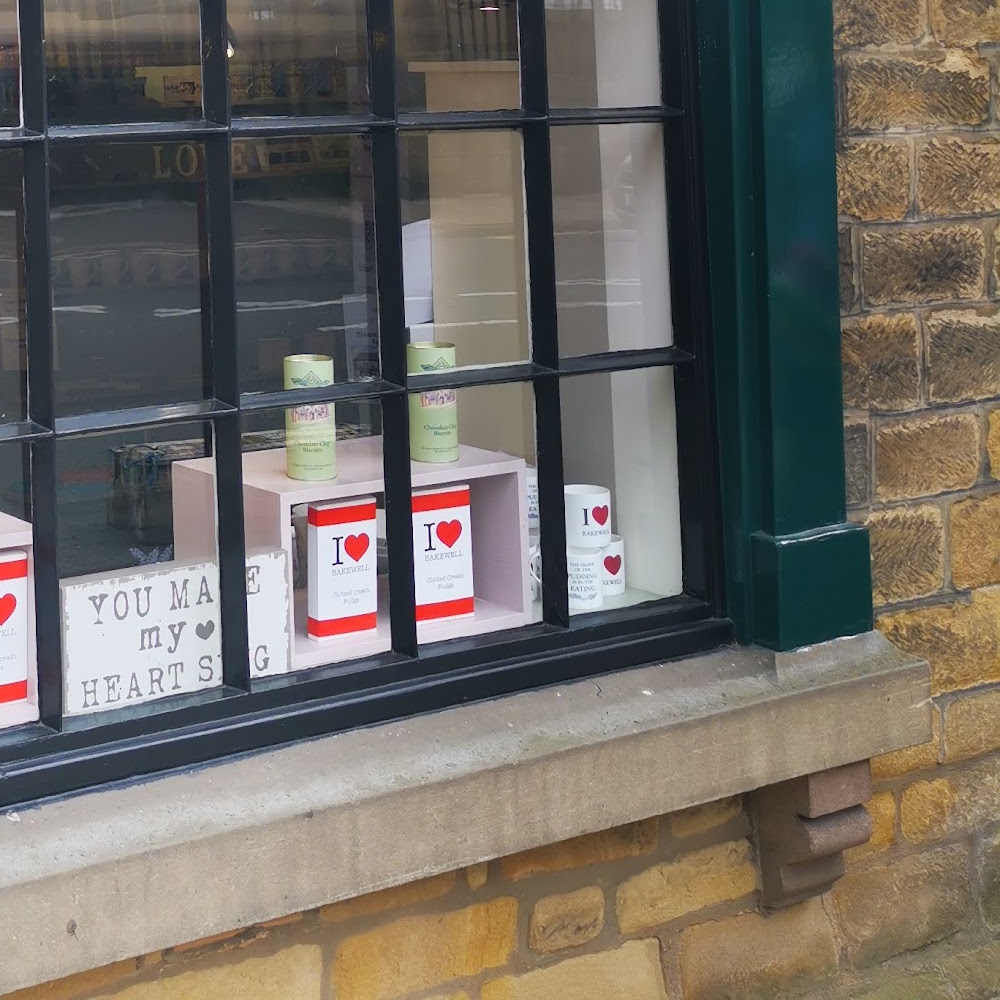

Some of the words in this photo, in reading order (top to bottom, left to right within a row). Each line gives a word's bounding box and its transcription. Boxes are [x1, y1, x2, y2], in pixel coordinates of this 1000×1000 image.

[152, 143, 248, 179] LOE
[582, 507, 590, 526] I
[332, 536, 344, 566] I
[423, 522, 437, 552] I
[331, 564, 370, 576] BAKEWELL
[424, 550, 464, 562] BAKEWELL
[88, 586, 152, 625] YOU
[169, 565, 261, 612] MAE
[138, 621, 187, 654] my
[81, 661, 184, 708] HEART
